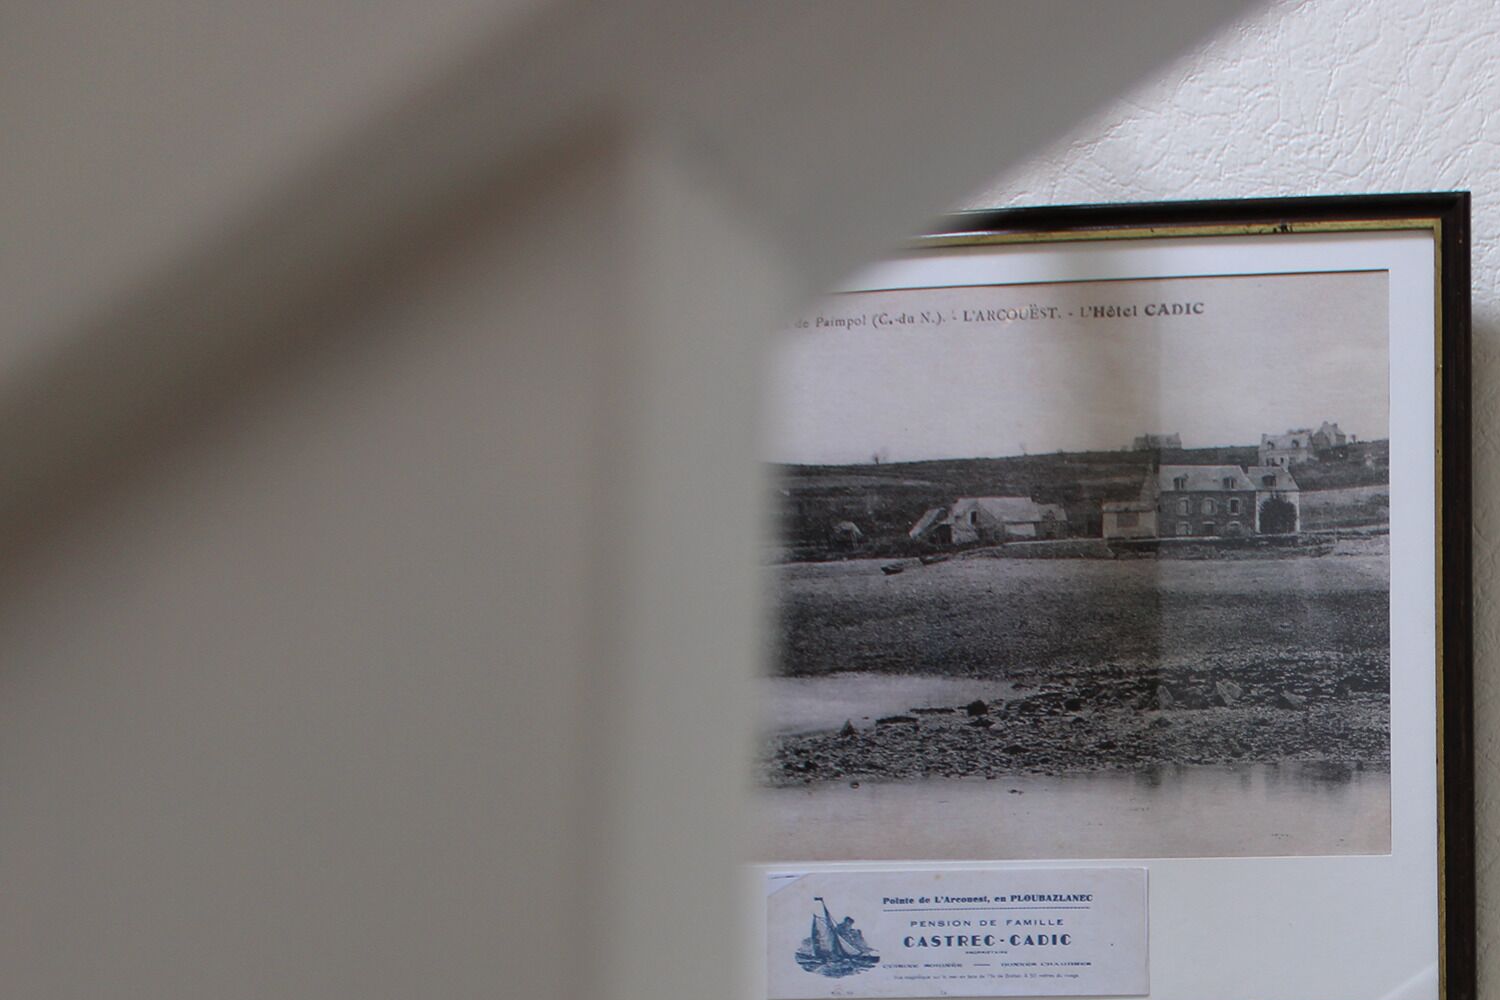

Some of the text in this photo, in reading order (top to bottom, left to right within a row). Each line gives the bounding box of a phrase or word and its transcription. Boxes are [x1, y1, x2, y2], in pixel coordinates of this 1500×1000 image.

[815, 314, 866, 330] Paimpol
[1080, 305, 1137, 318] L'Hôtel
[1144, 302, 1204, 316] CADIC
[883, 897, 914, 905] Pointe
[919, 896, 931, 904] de
[1010, 894, 1093, 903] PLOUBAZLANEC
[910, 920, 971, 928] PENSION
